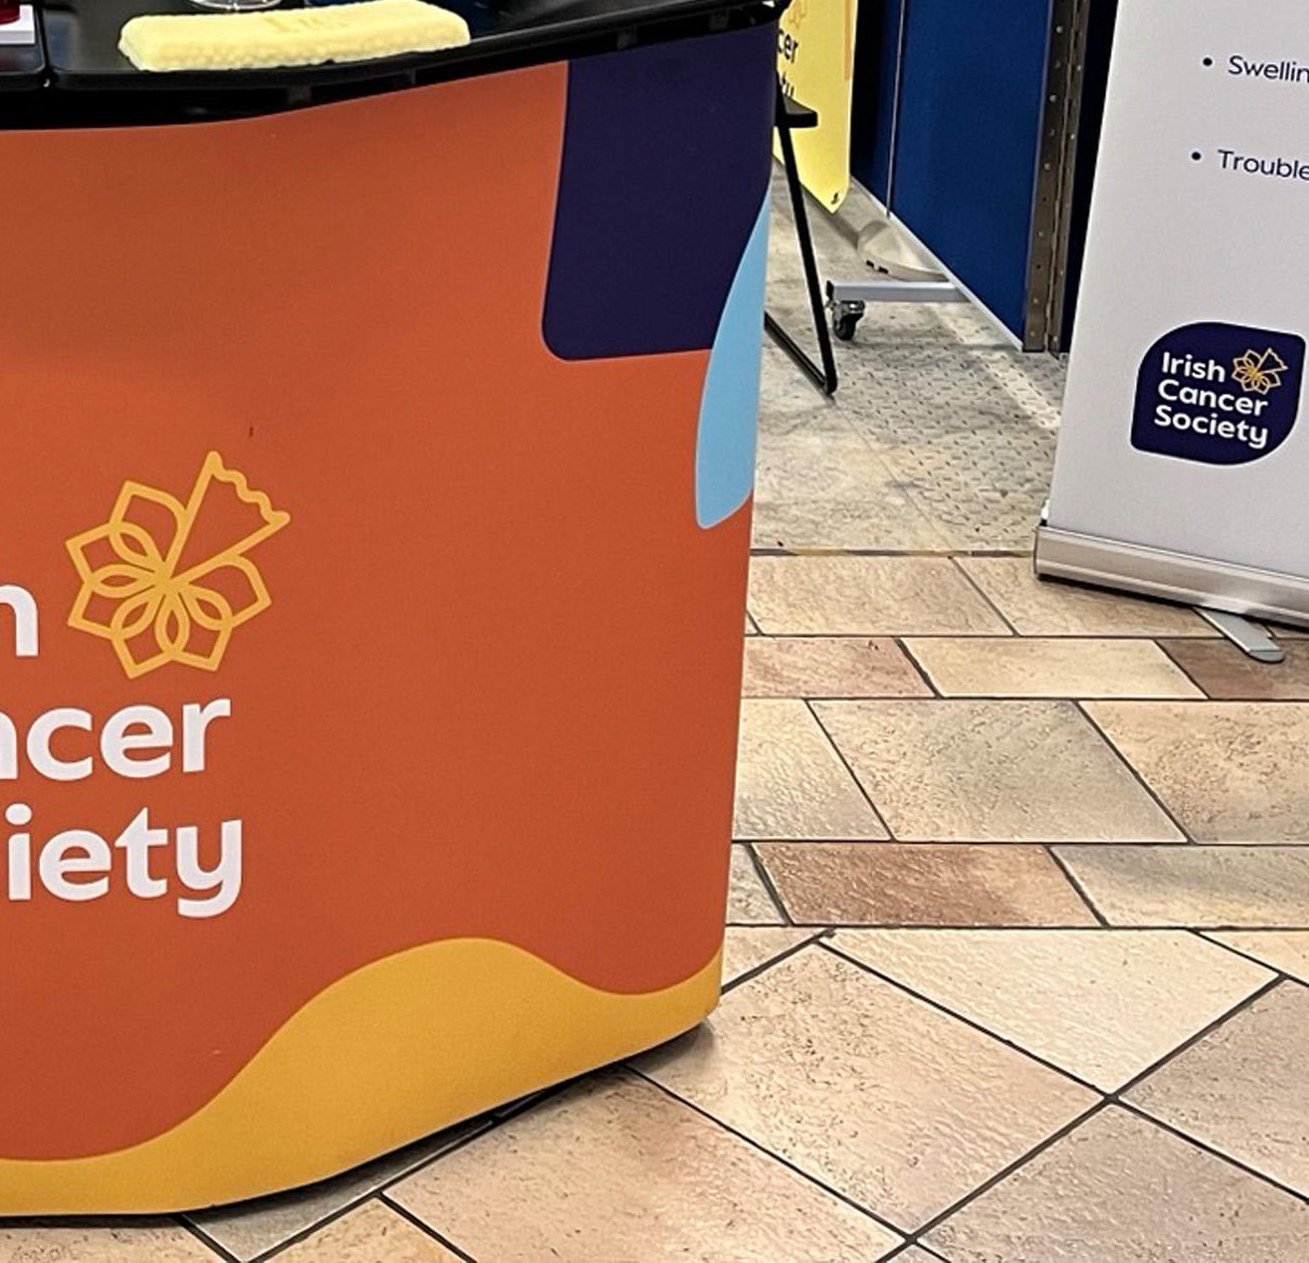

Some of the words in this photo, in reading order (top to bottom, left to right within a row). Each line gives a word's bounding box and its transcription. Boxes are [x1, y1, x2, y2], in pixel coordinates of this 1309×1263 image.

[1228, 55, 1309, 83] Swellin
[1217, 149, 1309, 181] Trouble
[1162, 351, 1225, 383] Irish
[1158, 379, 1268, 416] Cancer
[1154, 404, 1268, 450] Society
